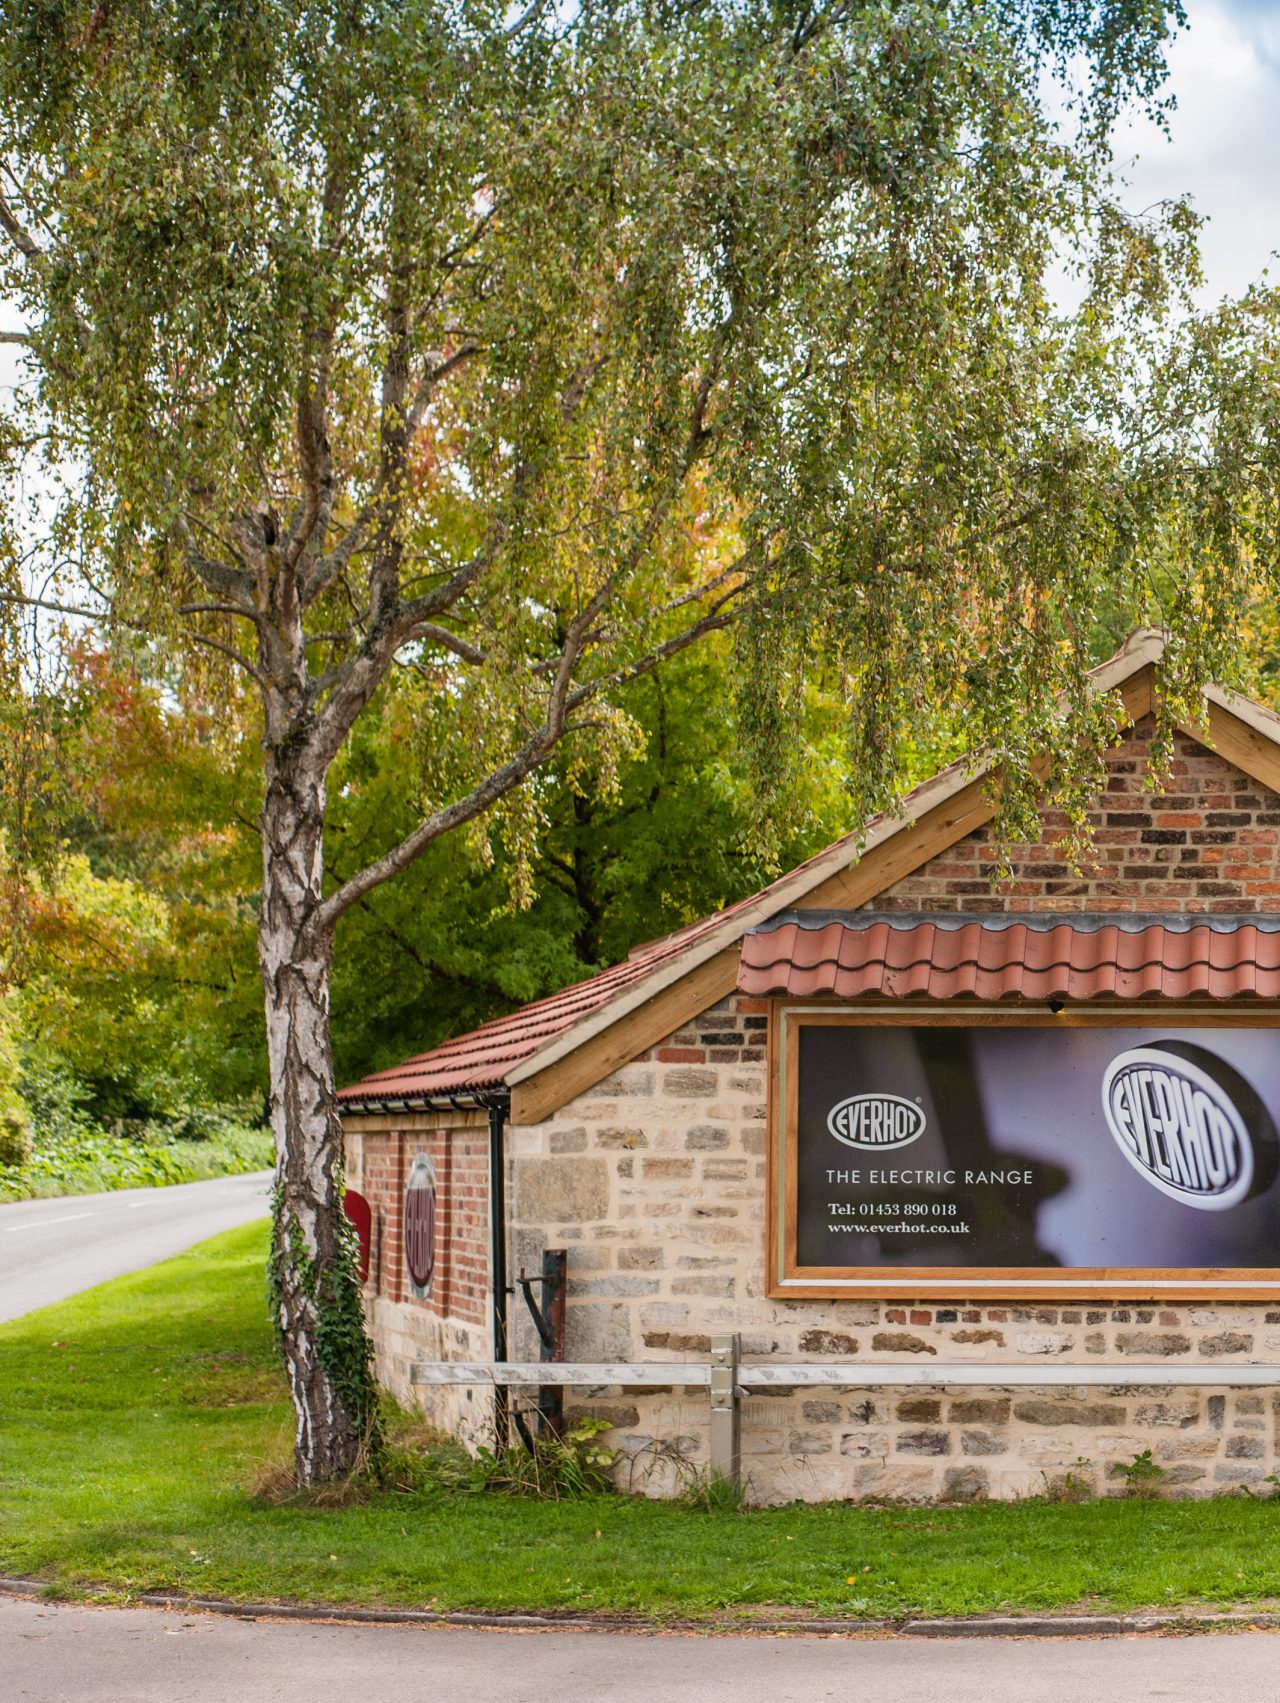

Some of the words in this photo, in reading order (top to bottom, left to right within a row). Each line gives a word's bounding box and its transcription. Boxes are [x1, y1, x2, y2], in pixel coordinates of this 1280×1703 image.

[836, 1100, 917, 1143] EVERHOT
[1113, 1069, 1238, 1191] EVERHOT
[826, 1170, 861, 1184] THE
[869, 1170, 956, 1184] ELECTRIC
[964, 1170, 1033, 1184] RANGE
[828, 1203, 856, 1215] Tel:
[859, 1203, 900, 1216] 01453
[903, 1203, 929, 1216] 890
[931, 1203, 957, 1216] 018
[828, 1221, 970, 1233] www.everhot.co.uk
